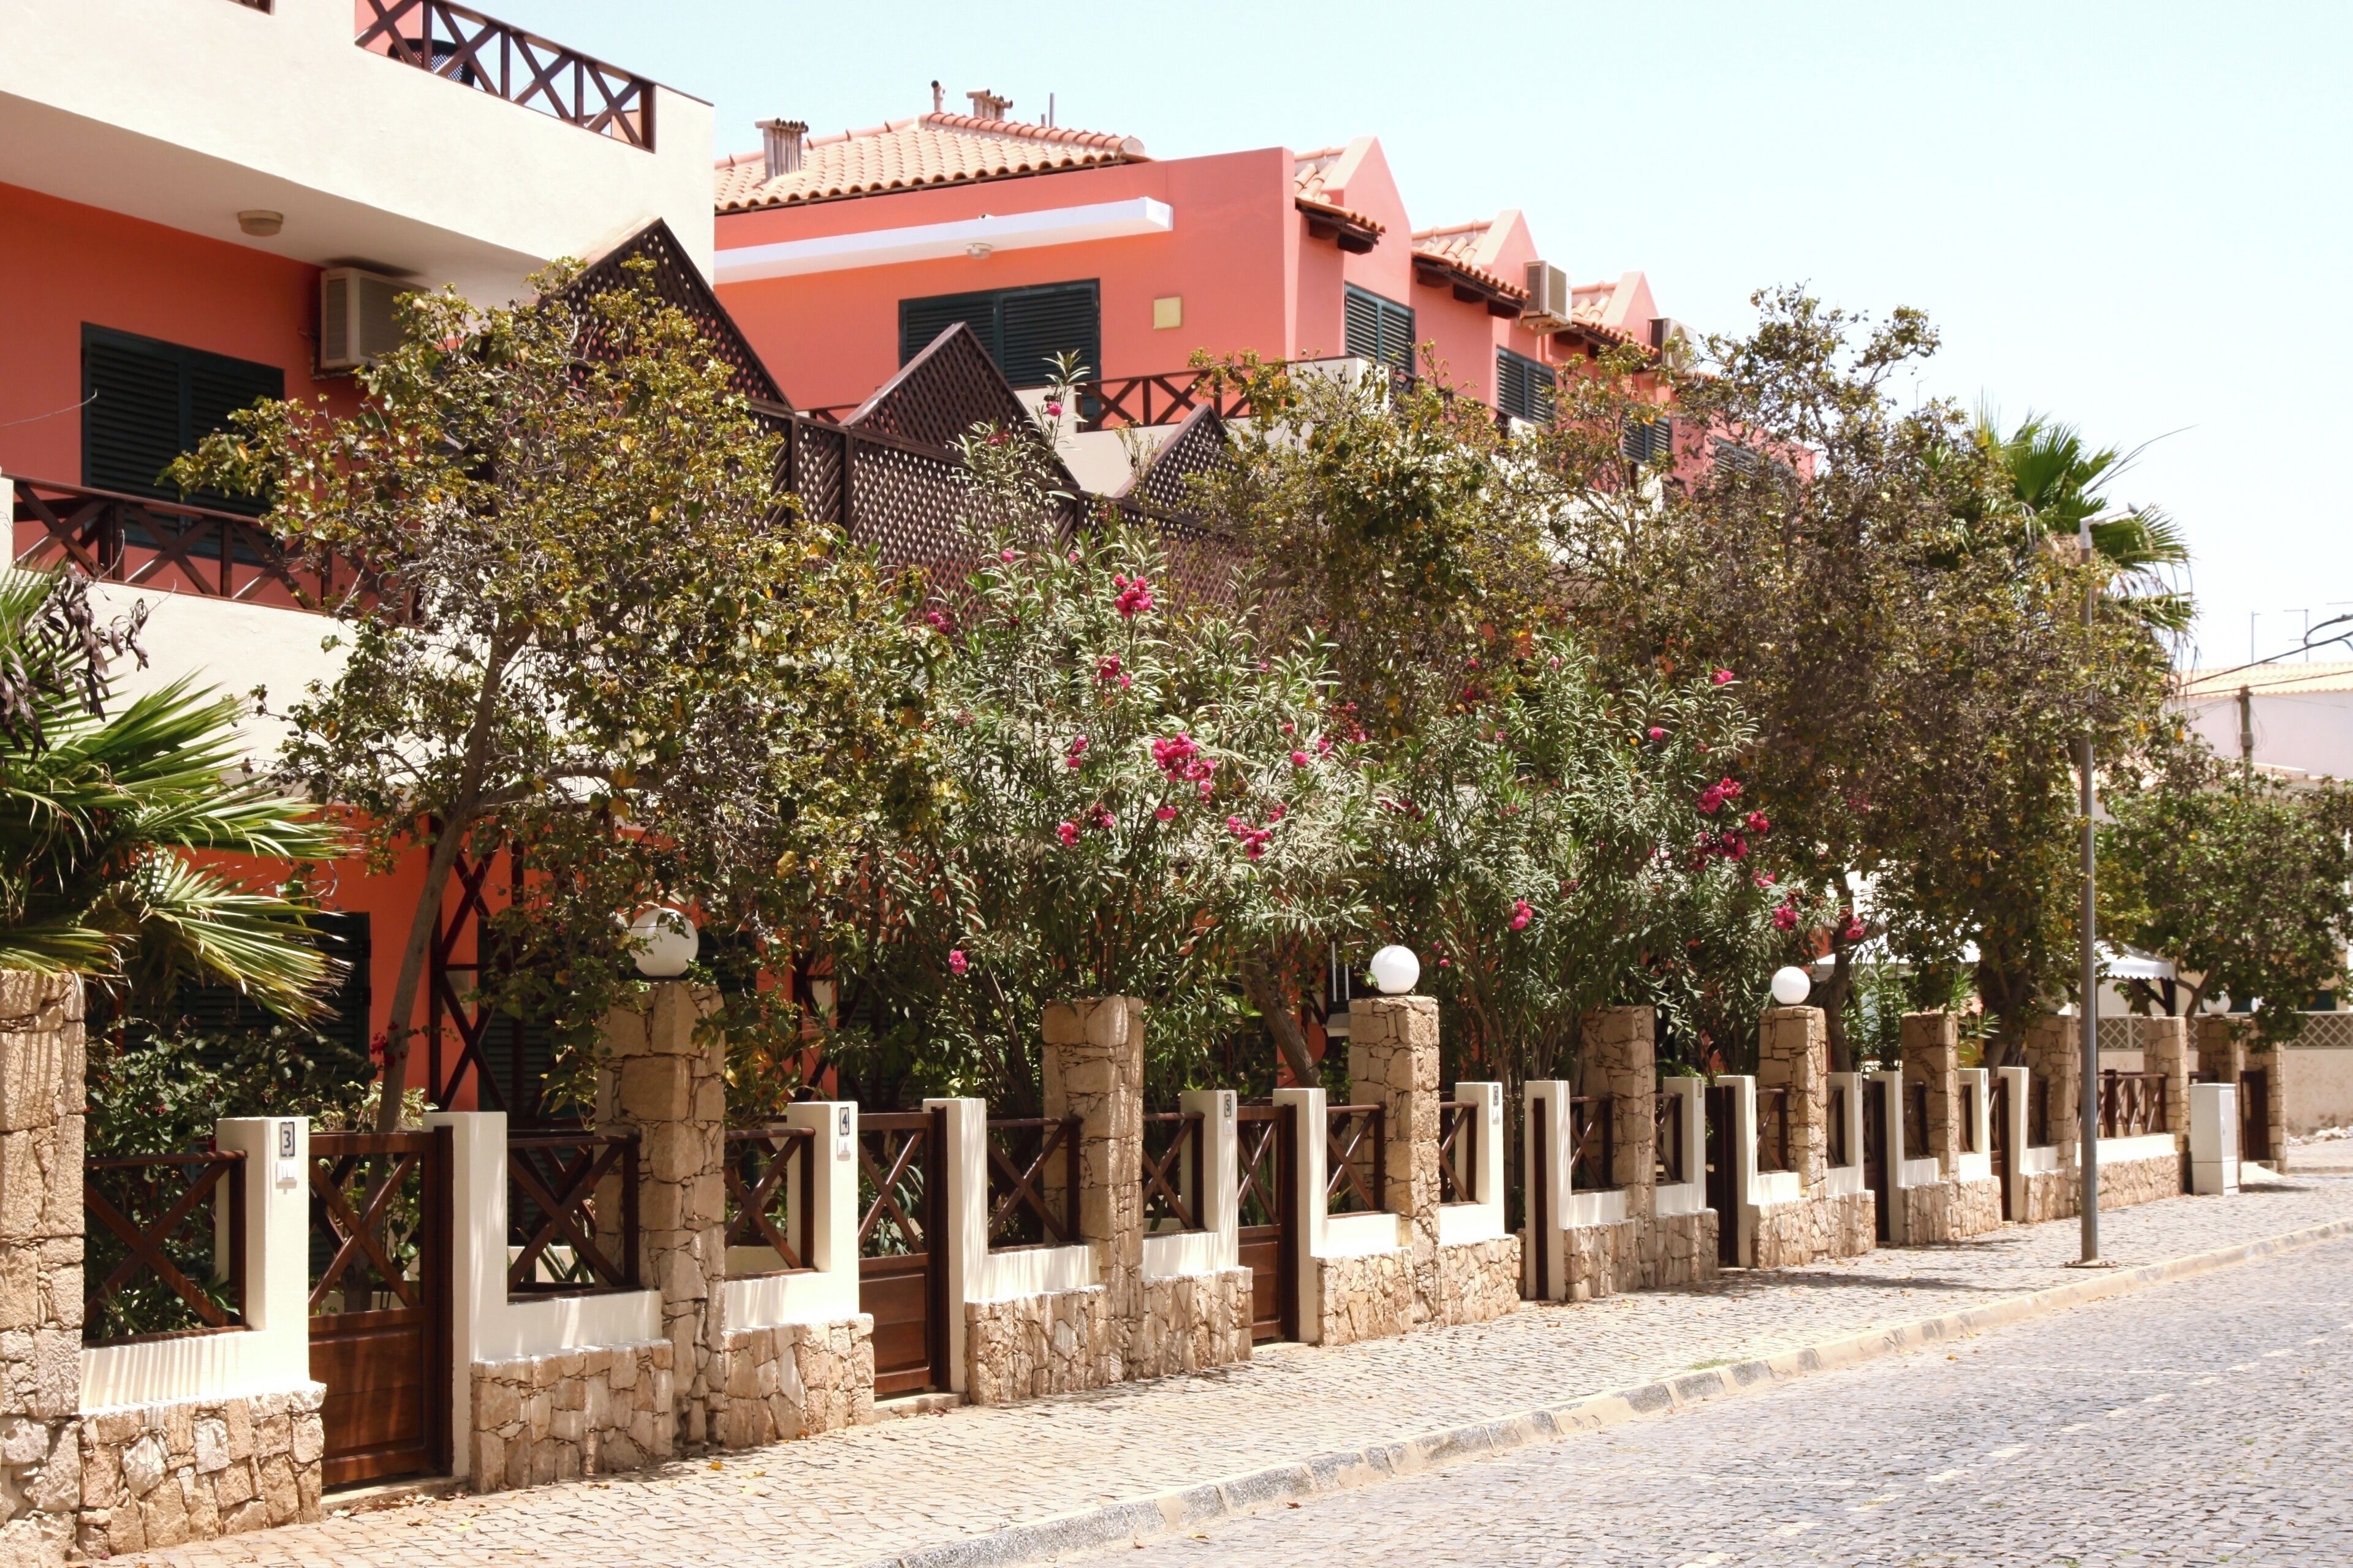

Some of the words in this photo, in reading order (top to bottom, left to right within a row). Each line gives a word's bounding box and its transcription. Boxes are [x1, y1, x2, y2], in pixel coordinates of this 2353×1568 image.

[1226, 1099, 1230, 1112] 5
[843, 1113, 847, 1129] 4
[284, 1131, 291, 1148] 3
